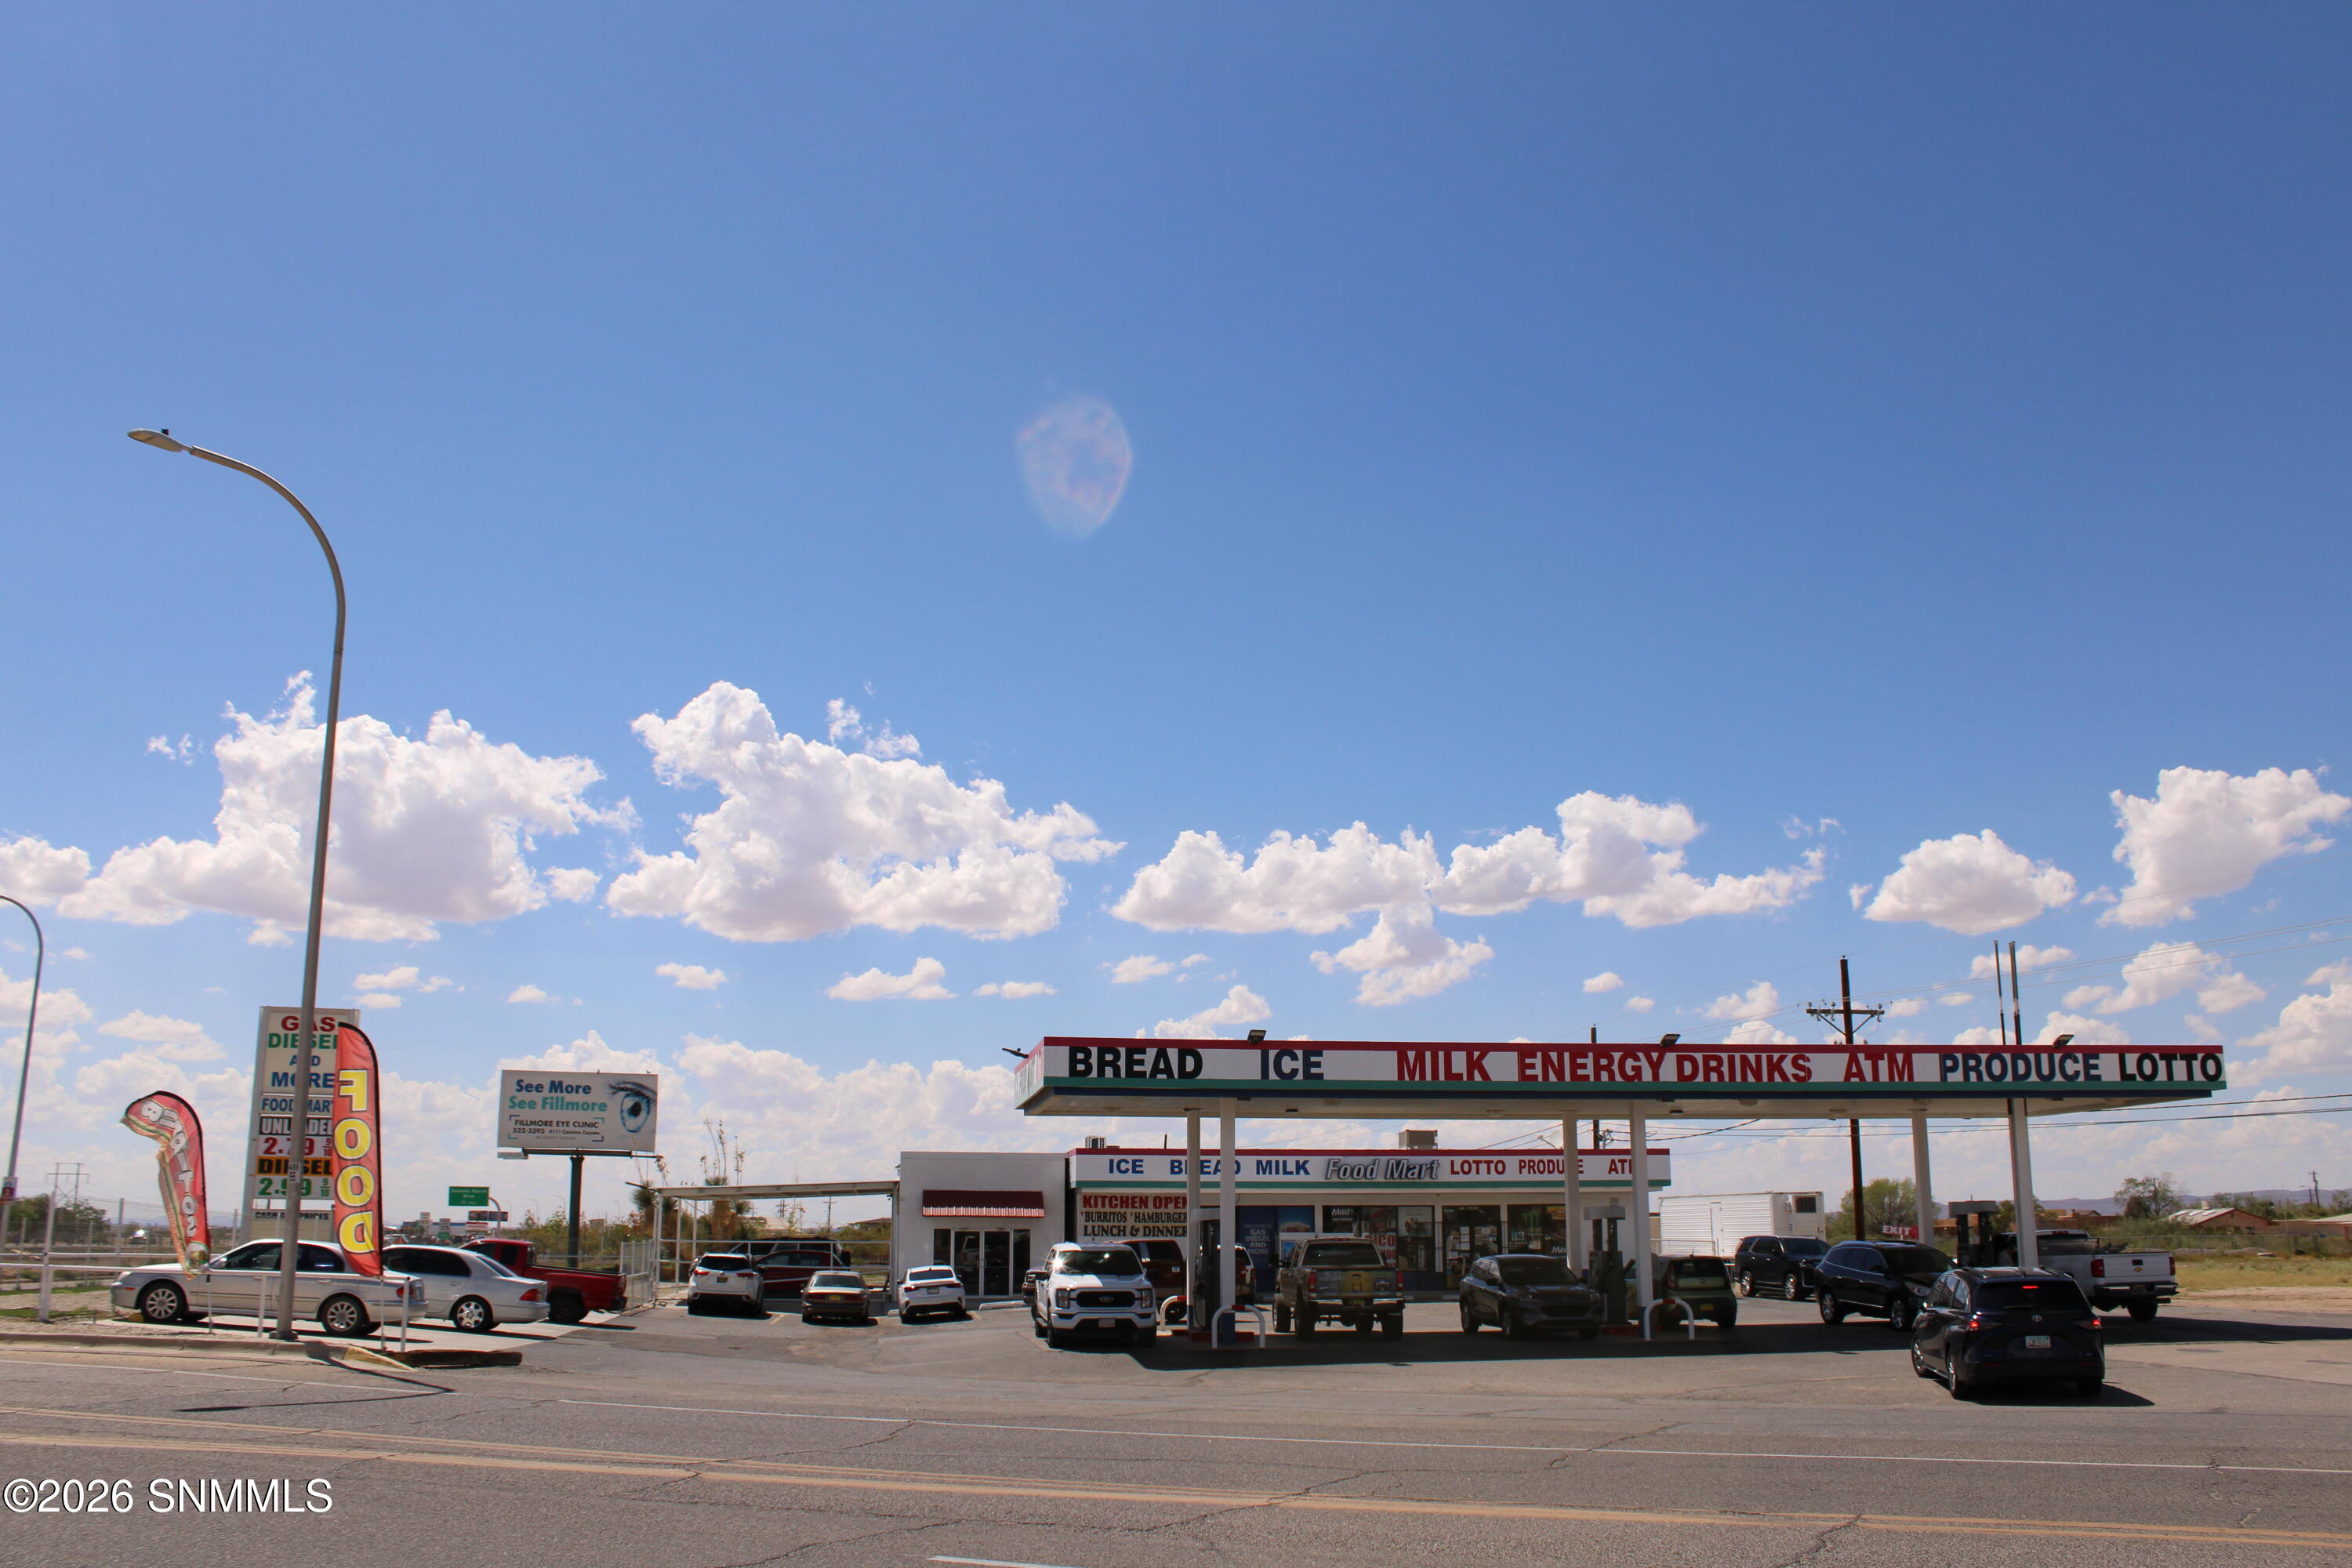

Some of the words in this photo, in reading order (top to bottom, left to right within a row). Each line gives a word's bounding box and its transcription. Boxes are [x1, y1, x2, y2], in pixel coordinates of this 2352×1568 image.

[281, 1016, 336, 1032] GS
[289, 1055, 320, 1066] AD
[1069, 1046, 1203, 1080] BREAD
[1261, 1049, 1324, 1080] ICE
[1397, 1051, 1492, 1081] MILK
[1519, 1051, 1667, 1082] ENERGY
[1676, 1054, 1812, 1083] DRINKS
[1843, 1053, 1915, 1082] ATM
[1942, 1053, 2102, 1082] PRODUCE
[2118, 1053, 2223, 1082] LOTTO
[271, 1072, 335, 1088] MRE
[516, 1079, 544, 1093] See
[549, 1080, 591, 1094] More
[307, 1100, 334, 1112] MAR
[508, 1097, 537, 1109] See
[541, 1097, 608, 1112] Fillmore
[261, 1117, 332, 1135] UNLDE
[1109, 1159, 1144, 1174] ICE
[1170, 1160, 1242, 1175] BEAD
[1256, 1160, 1310, 1175] MILK
[1325, 1158, 1380, 1180] Food
[1384, 1158, 1440, 1180] Mart
[1450, 1160, 1506, 1175] LOTTO
[1519, 1159, 1584, 1174] PRODUE
[1083, 1195, 1149, 1209] KITCHEN
[1153, 1195, 1187, 1209] OPEN
[1085, 1211, 1127, 1223] BURRITOS
[1083, 1225, 1127, 1237] LUNCH
[1130, 1225, 1139, 1237] &
[1882, 1225, 1911, 1236] EXIT
